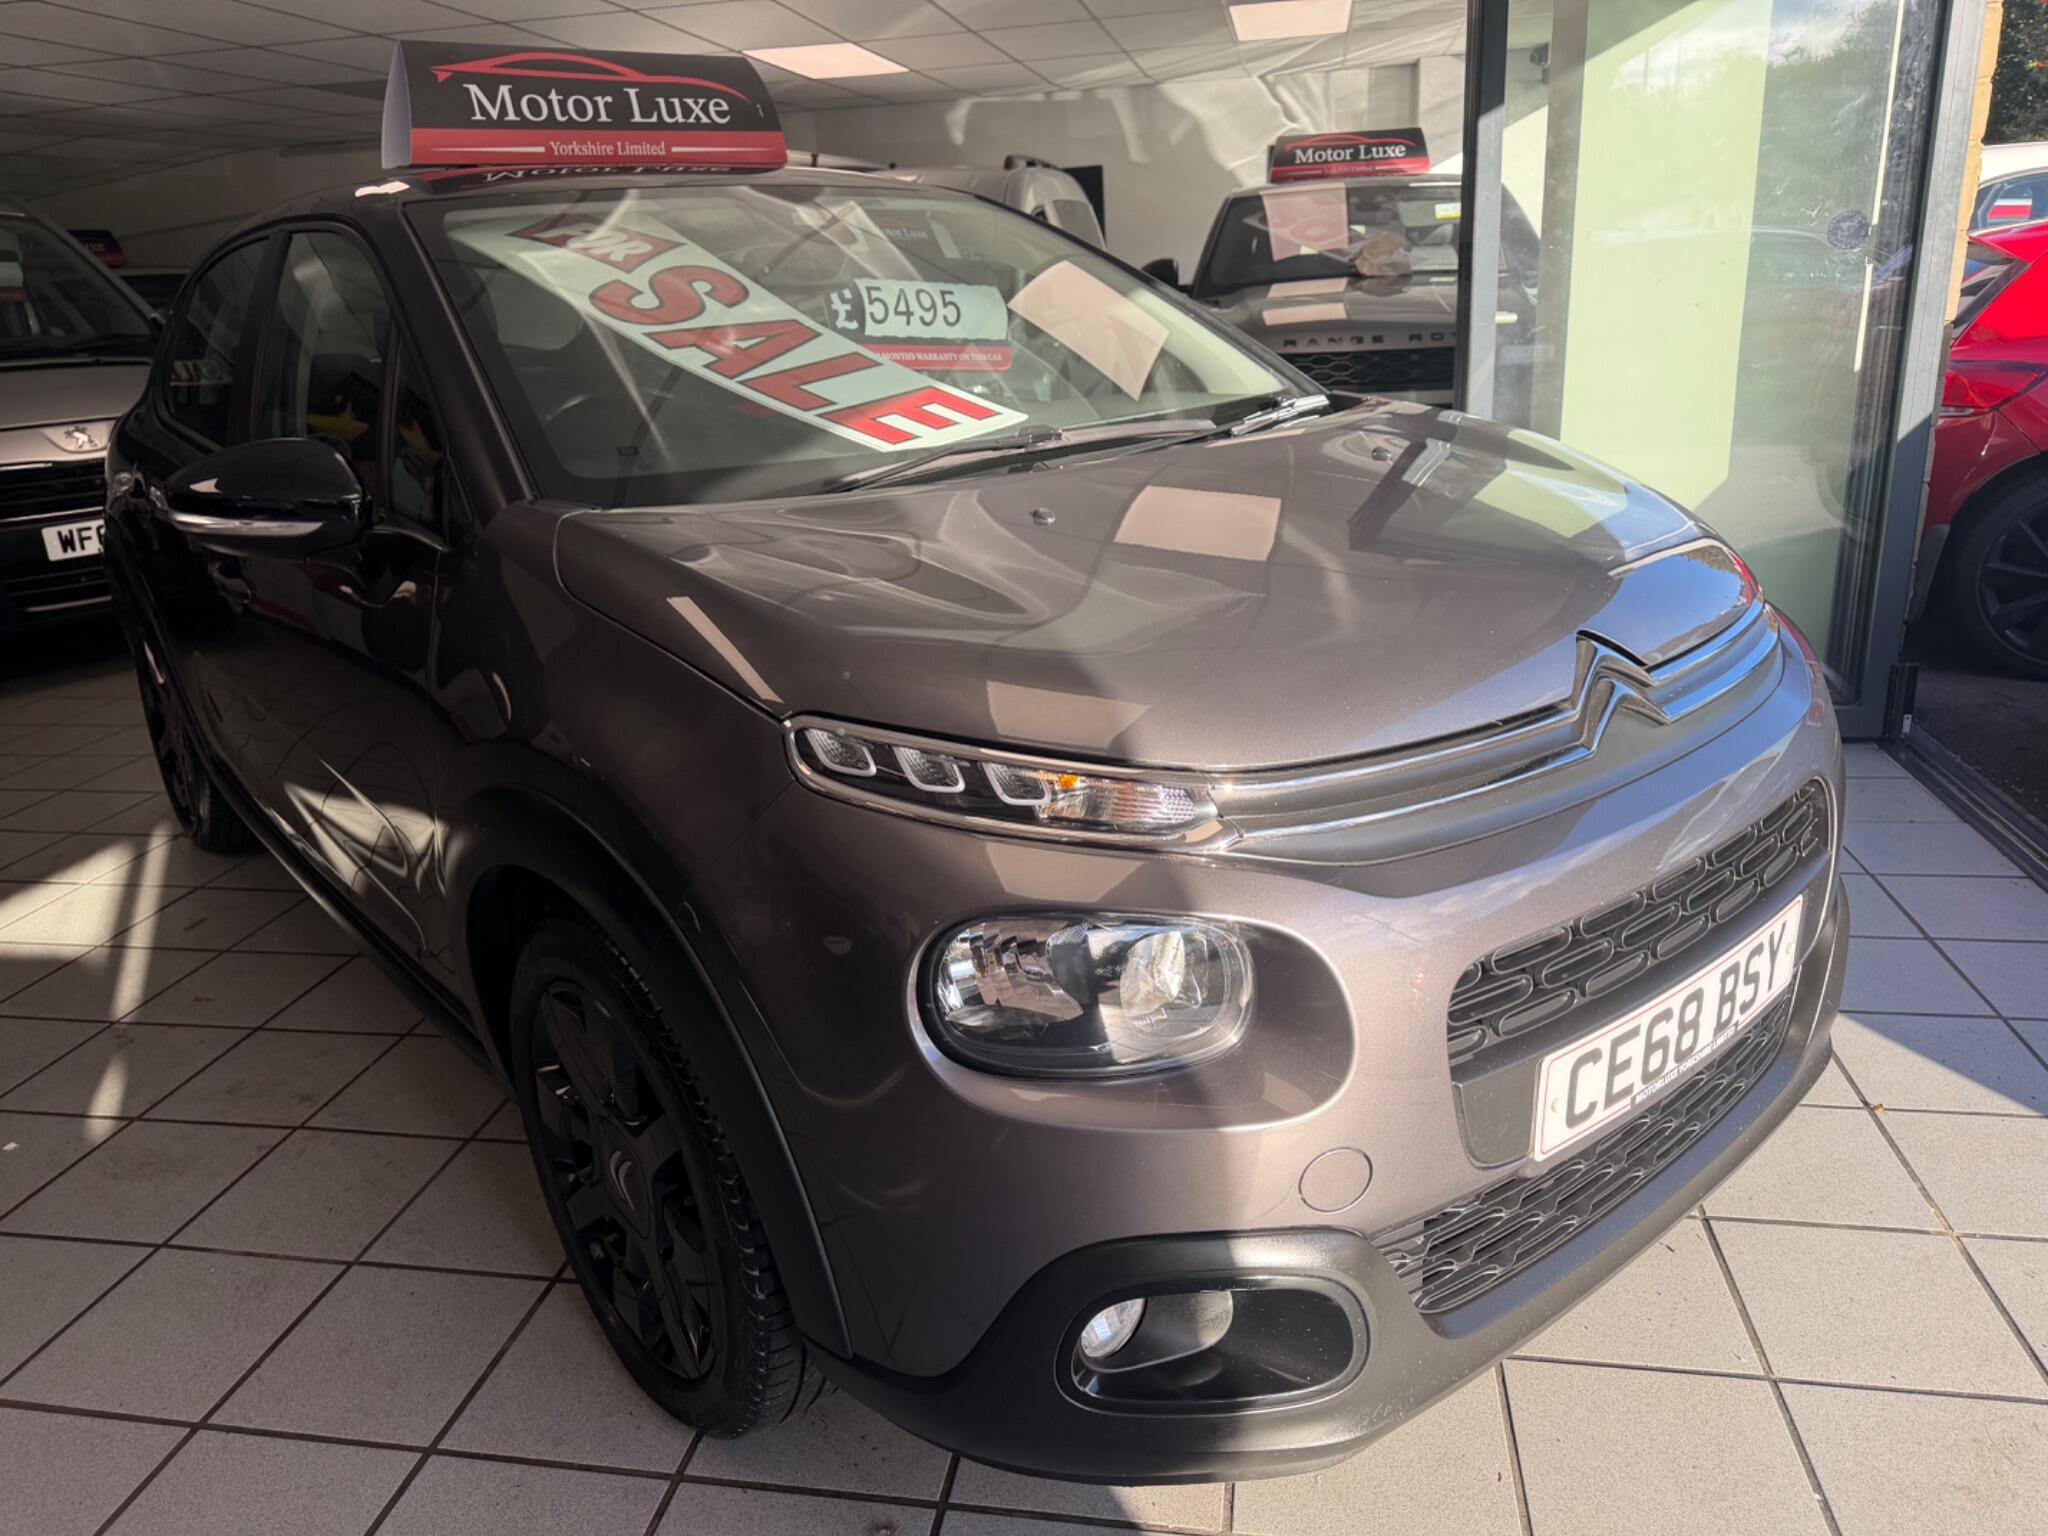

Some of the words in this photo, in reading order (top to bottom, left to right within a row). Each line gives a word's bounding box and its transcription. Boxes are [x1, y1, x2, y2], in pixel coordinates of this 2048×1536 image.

[463, 83, 613, 123] Motor
[622, 87, 732, 125] Luxe
[550, 140, 614, 157] Yorkshire
[616, 141, 667, 156] Limited
[1294, 147, 1355, 165] Motor
[1358, 144, 1407, 160] Luxe
[533, 221, 653, 262] FOR
[588, 265, 1003, 446] SALE
[1283, 334, 1385, 348] RANGE
[1408, 332, 1457, 343] RO
[881, 351, 915, 362] MONTHS
[915, 351, 958, 361] WARRANTY
[958, 352, 971, 361] ON
[987, 353, 1003, 361] CAR
[1565, 986, 1705, 1129] CE68
[1713, 920, 1787, 1037] BSY
